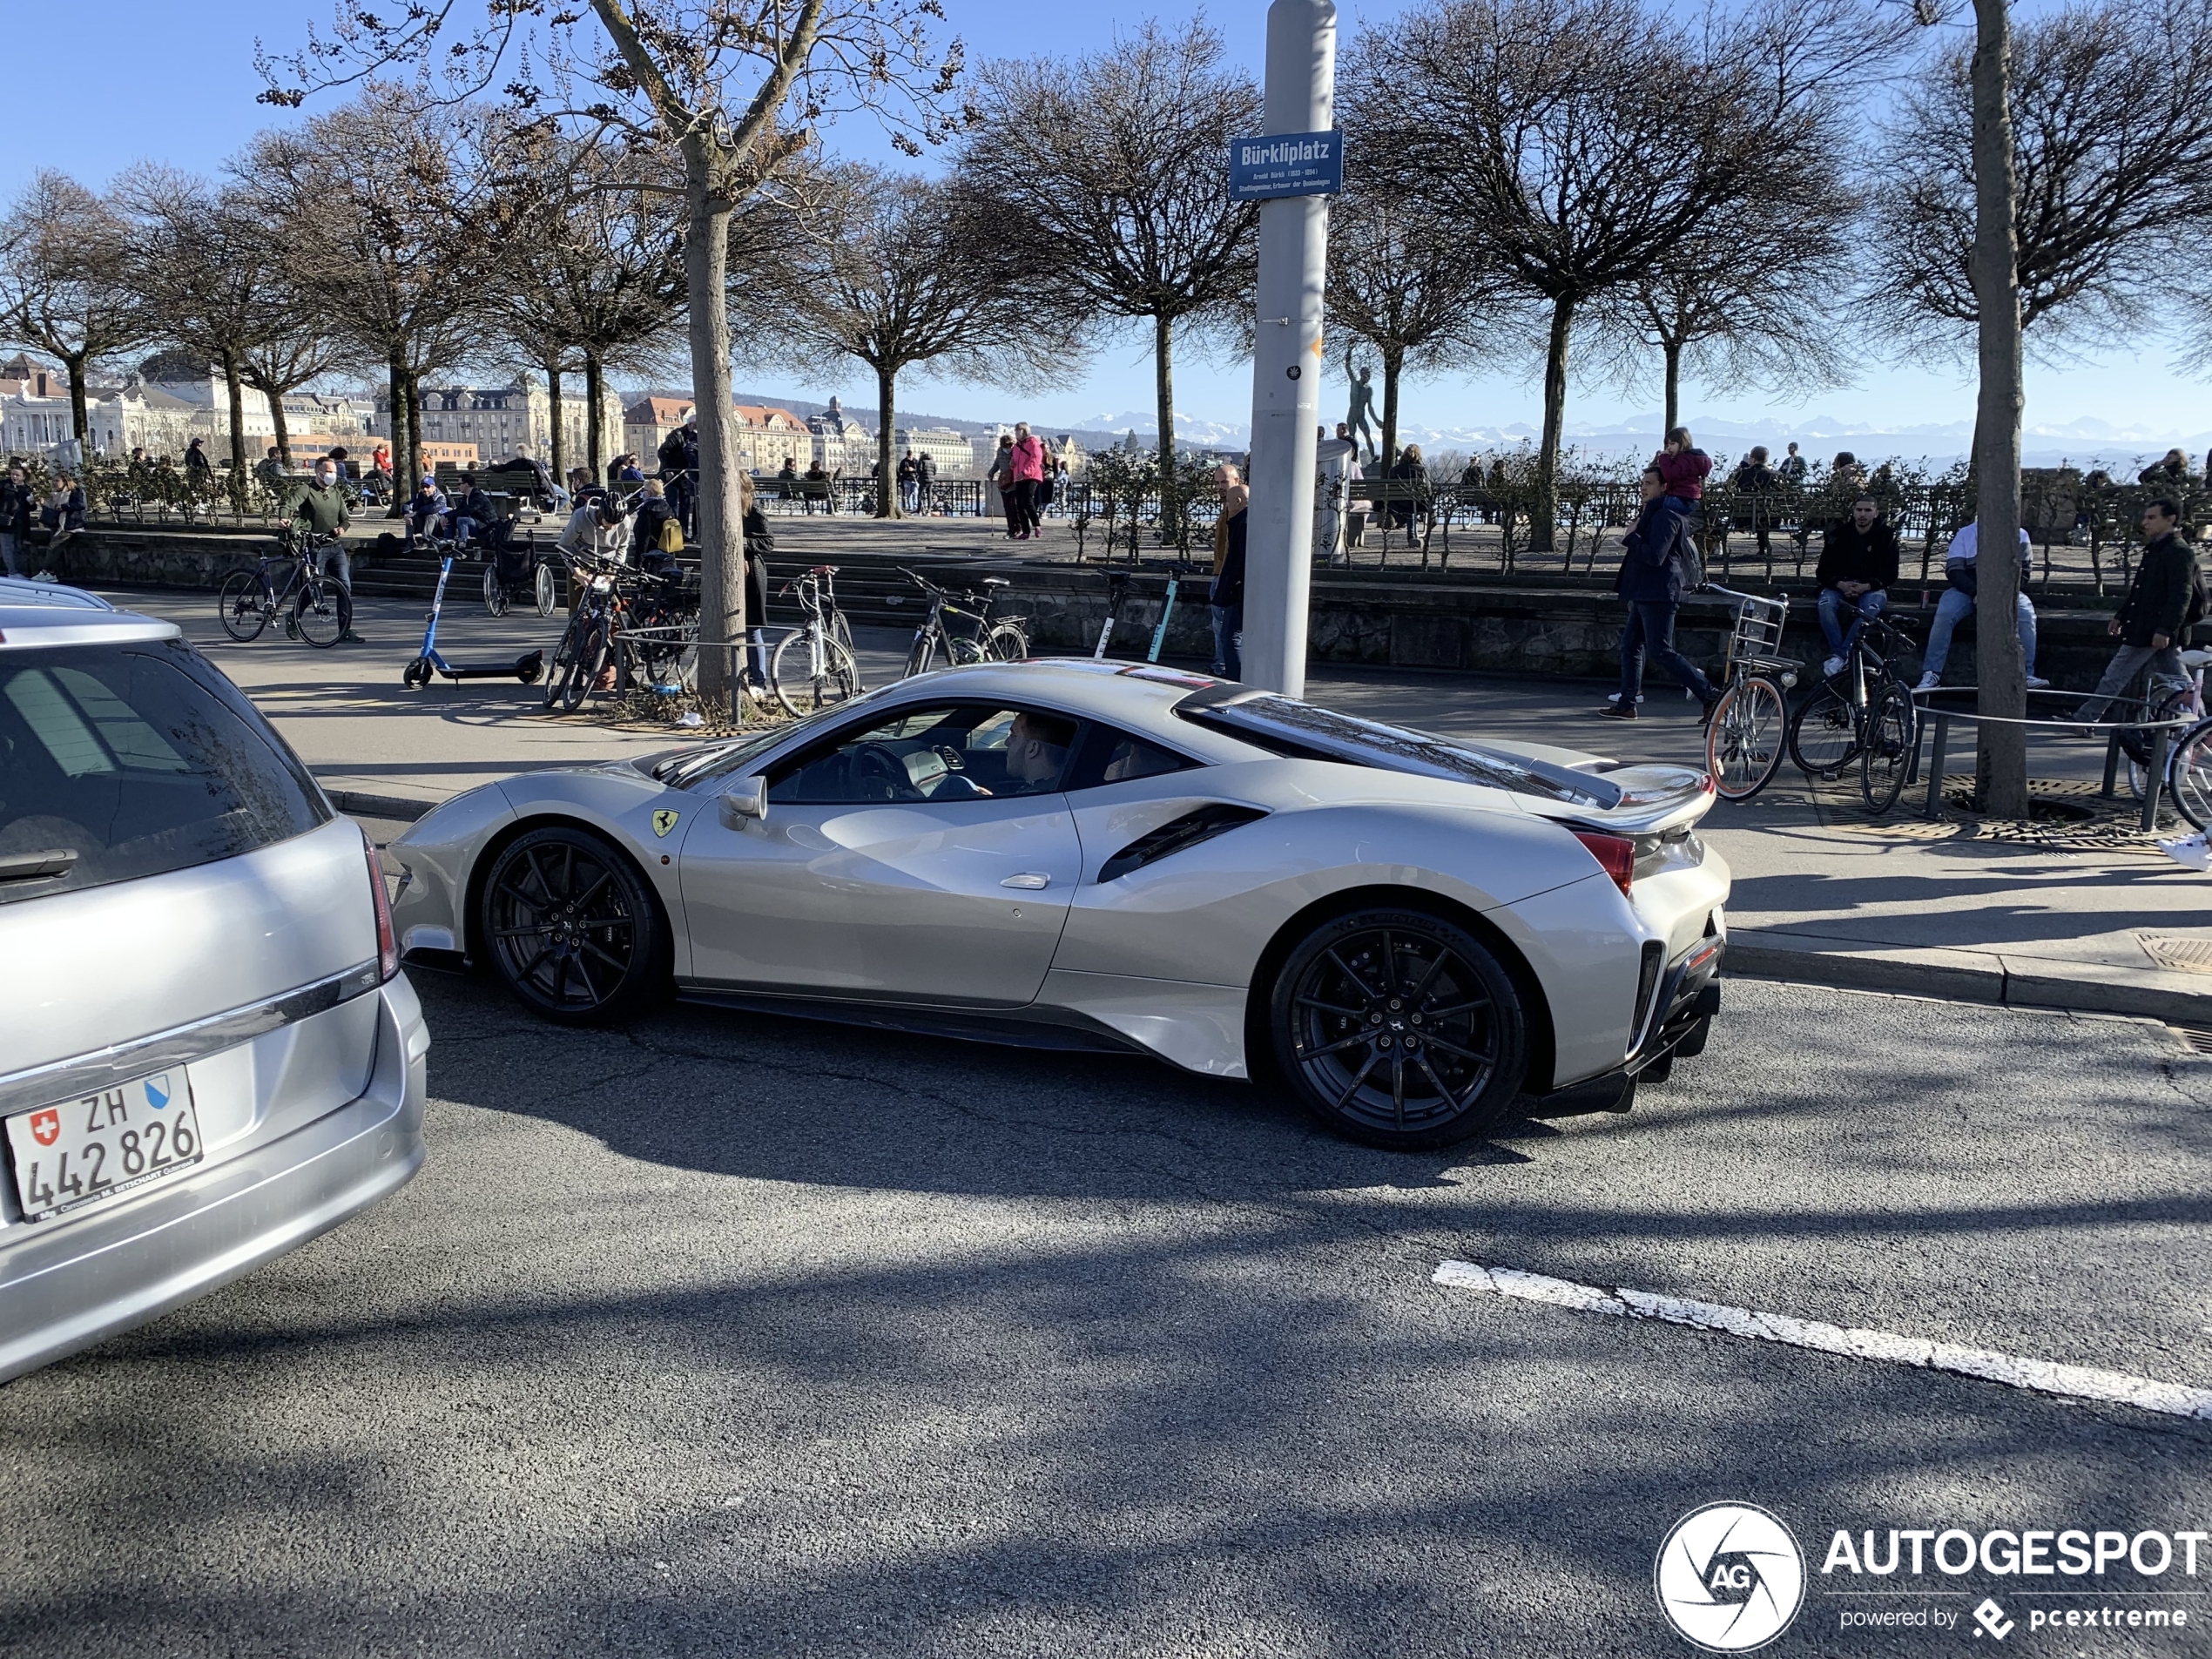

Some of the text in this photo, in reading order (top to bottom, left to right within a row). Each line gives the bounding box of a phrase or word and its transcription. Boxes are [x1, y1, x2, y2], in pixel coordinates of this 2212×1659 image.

[1242, 141, 1329, 165] Bürkliplatz
[1150, 625, 1162, 655] TIER
[1374, 914, 1435, 929] MICHELIN
[81, 1089, 128, 1133] ZH
[28, 1110, 194, 1207] 442 826
[60, 1193, 101, 1213] Carrosserie
[101, 1188, 114, 1199] M.
[115, 1170, 164, 1194] BETSCHART
